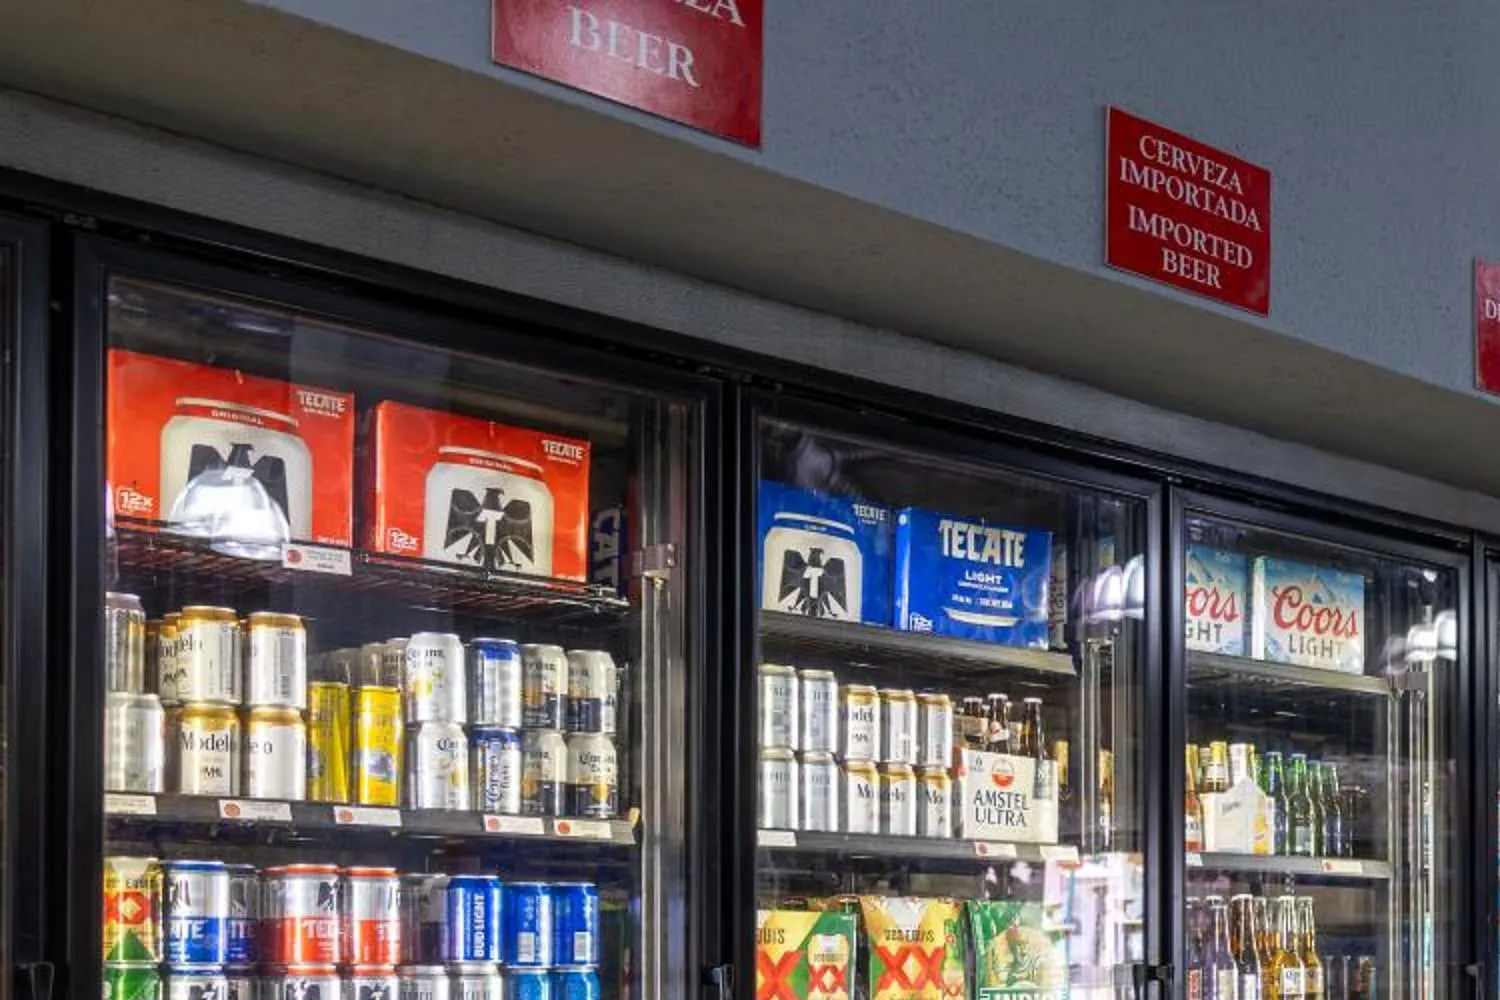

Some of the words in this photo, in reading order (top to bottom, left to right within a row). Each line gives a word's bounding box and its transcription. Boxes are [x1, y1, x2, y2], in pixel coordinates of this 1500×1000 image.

[565, 5, 700, 87] BEER
[1139, 135, 1244, 195] CERVEZA
[1119, 156, 1262, 232] IMPORTADA
[1127, 202, 1253, 269] IMPORTED
[1161, 248, 1222, 289] BEER
[297, 390, 347, 413] TECATE
[541, 439, 584, 460] TECATE
[938, 519, 1028, 569] TECATE
[965, 570, 1003, 585] LIGHT
[1272, 584, 1359, 640] Coors
[1288, 633, 1345, 657] LIGHT
[974, 788, 1029, 811] AMSTEL
[975, 808, 1028, 828] ULTRA
[474, 894, 485, 931] LIGHT
[474, 931, 485, 958] BUD
